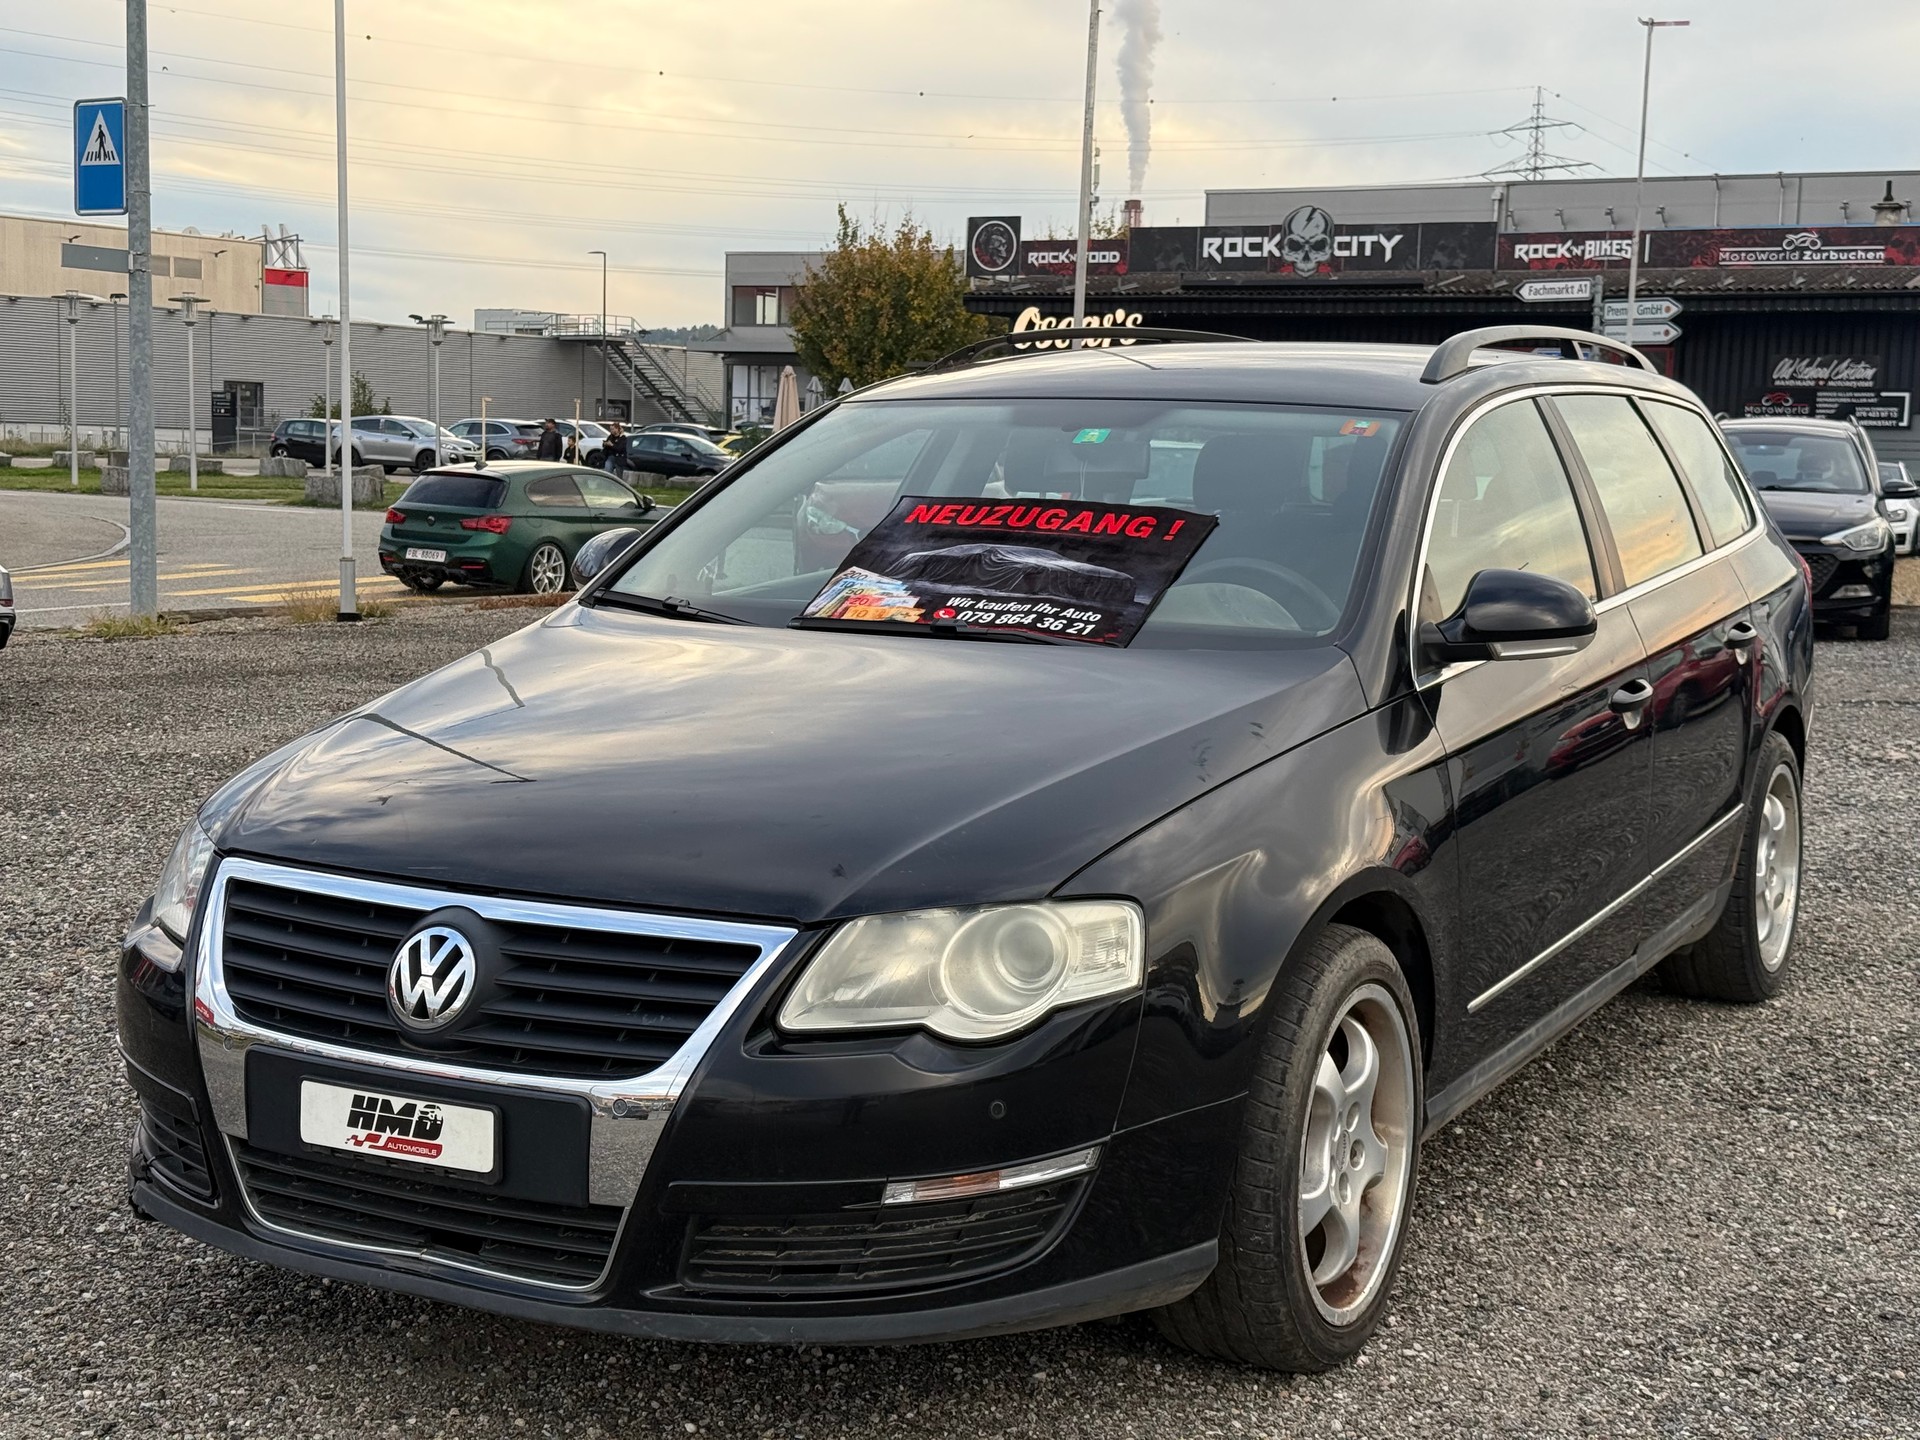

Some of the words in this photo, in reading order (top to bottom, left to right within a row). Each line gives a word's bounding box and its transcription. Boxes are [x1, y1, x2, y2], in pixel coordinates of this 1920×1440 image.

[1202, 233, 1281, 264] ROCK
[1333, 233, 1404, 263] CITY
[1719, 250, 1799, 262] MotoWorld
[1802, 249, 1885, 261] Zurbuchen
[1528, 284, 1574, 296] Fachmarkt
[1577, 283, 1588, 294] A1
[1636, 303, 1662, 315] GmbH
[904, 505, 1156, 538] NEUZUGANG
[1164, 520, 1185, 541] !
[845, 588, 864, 596] 50
[849, 597, 869, 605] 20
[851, 609, 868, 618] 10
[946, 597, 976, 608] Wir
[975, 599, 1032, 612] kaufen
[1032, 603, 1061, 615] Ihr
[1060, 608, 1102, 622] Auto
[956, 610, 995, 623] 079
[995, 613, 1038, 625] 864
[1036, 617, 1067, 631] 36
[1065, 622, 1096, 636] 21
[396, 931, 470, 1025] VW
[387, 1142, 437, 1156] AUTOMOBILE
